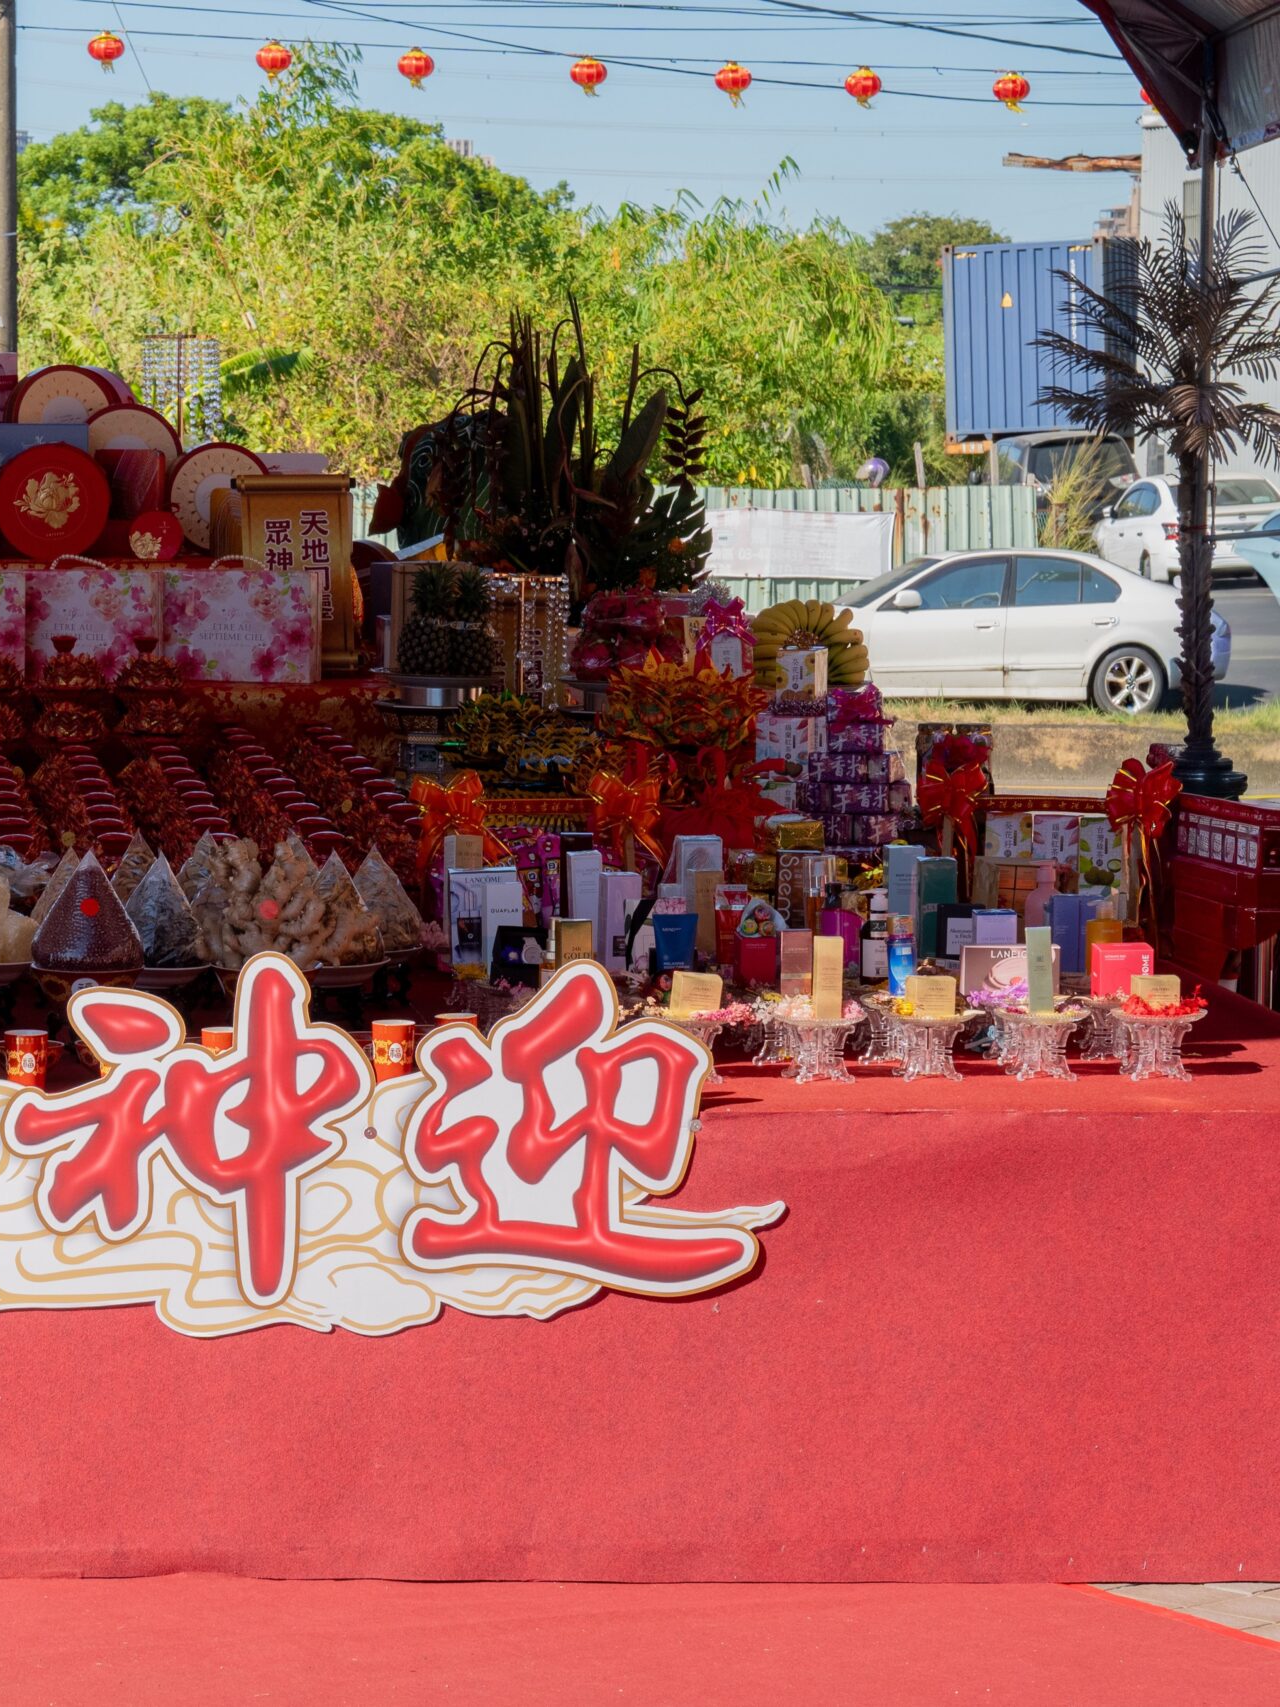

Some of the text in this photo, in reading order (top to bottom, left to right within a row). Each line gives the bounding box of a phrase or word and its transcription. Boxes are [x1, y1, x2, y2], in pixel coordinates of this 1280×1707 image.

[810, 753, 862, 779] 芋香米
[833, 783, 888, 814] 芋香米
[990, 950, 1027, 959] LANEIG
